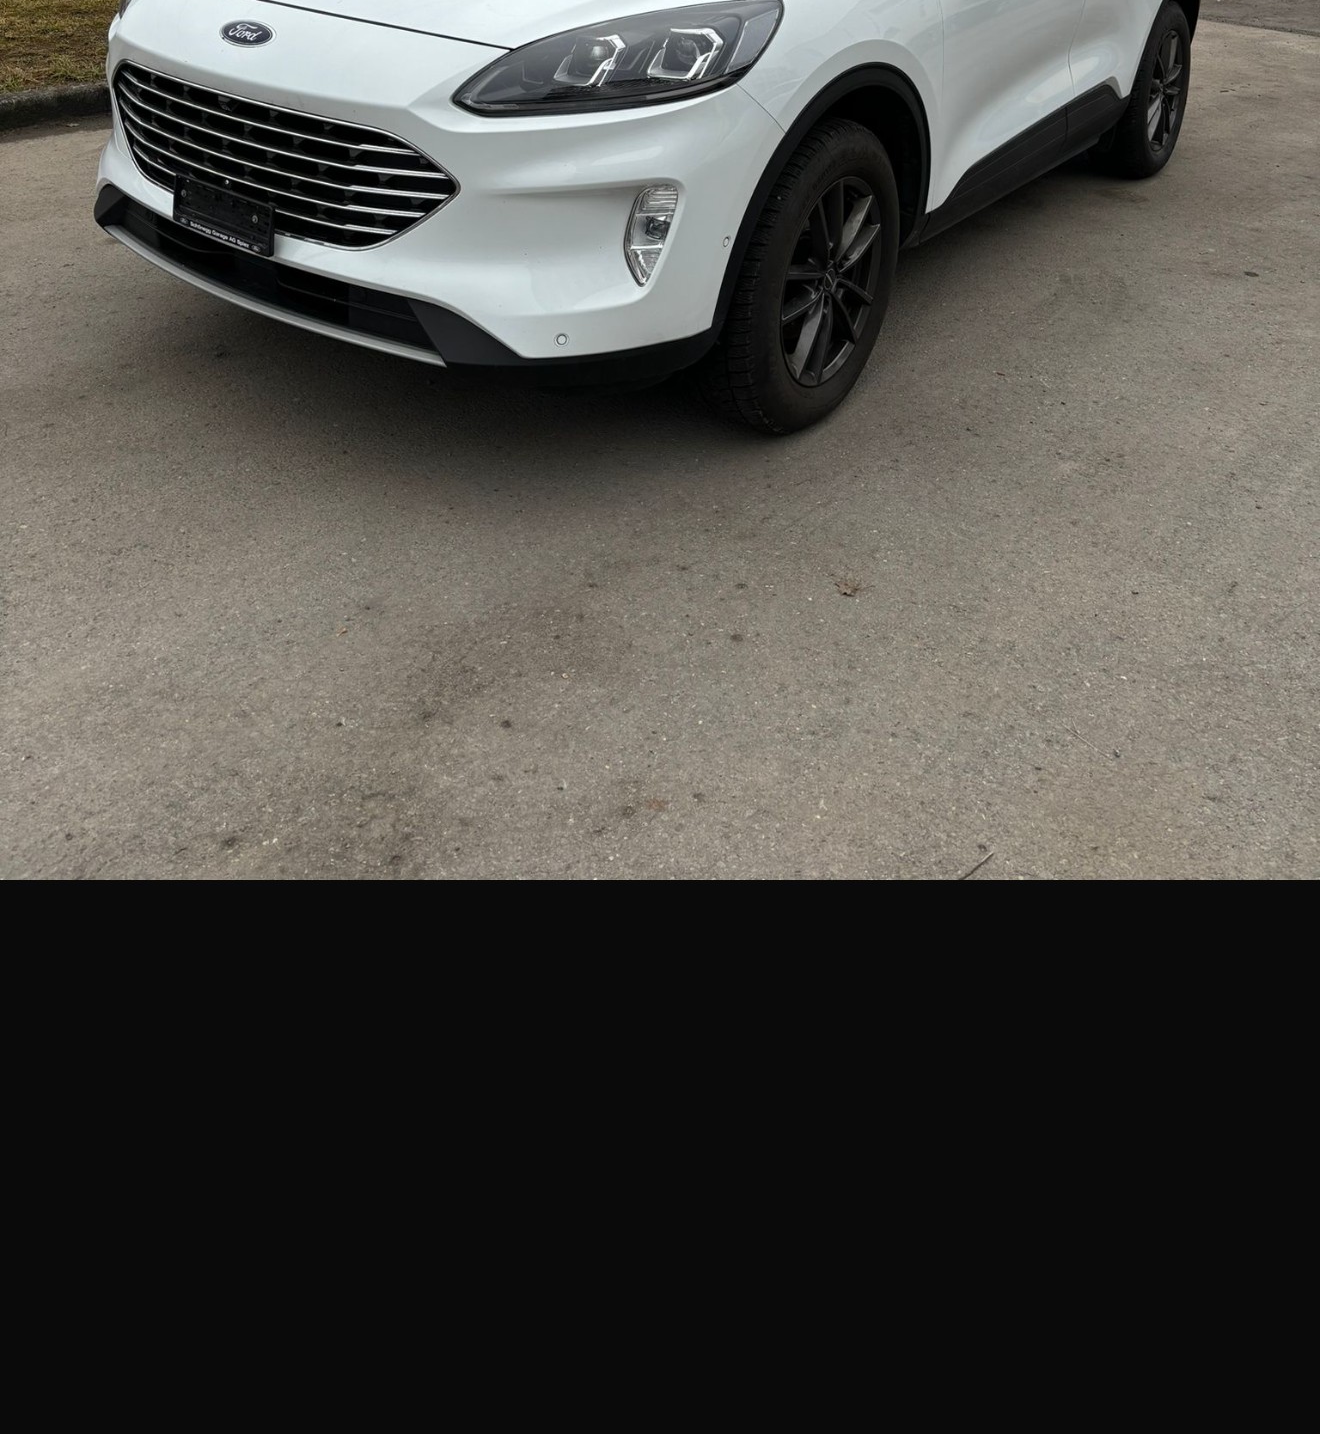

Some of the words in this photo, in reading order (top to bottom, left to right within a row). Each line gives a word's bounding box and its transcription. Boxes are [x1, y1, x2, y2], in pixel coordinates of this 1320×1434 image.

[228, 22, 263, 41] Ford
[212, 229, 229, 241] Garage
[229, 235, 237, 244] AG
